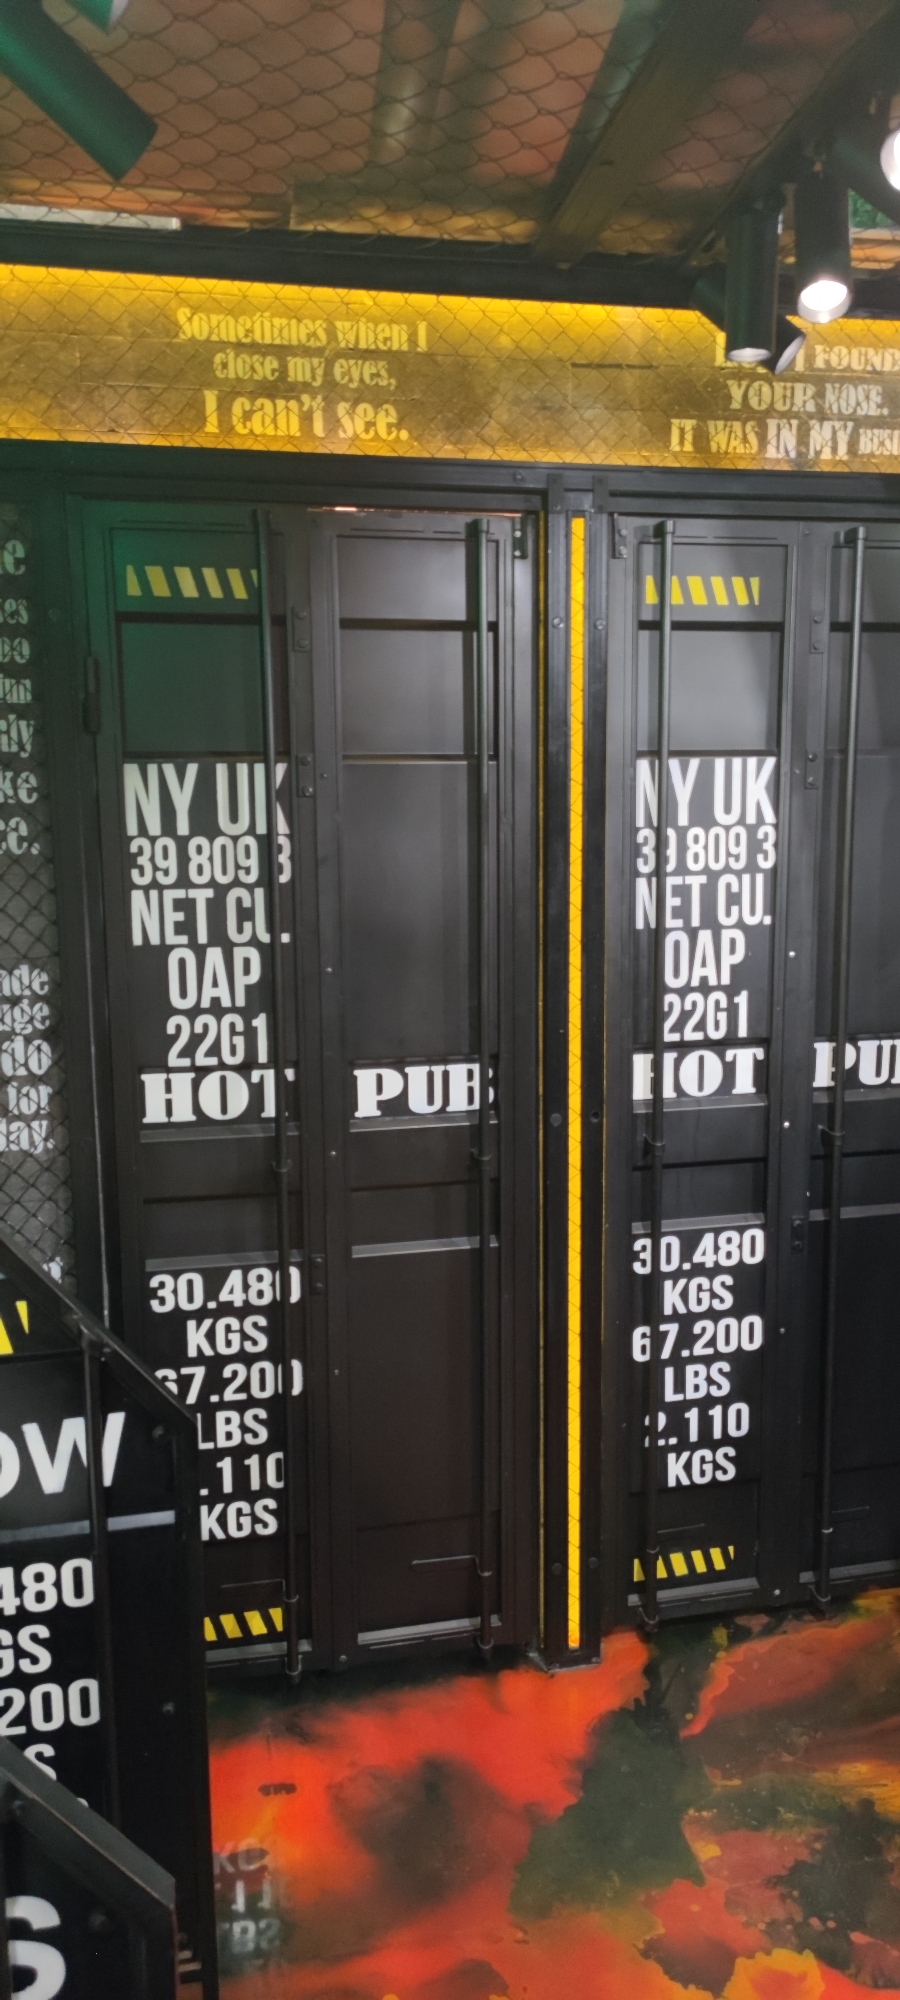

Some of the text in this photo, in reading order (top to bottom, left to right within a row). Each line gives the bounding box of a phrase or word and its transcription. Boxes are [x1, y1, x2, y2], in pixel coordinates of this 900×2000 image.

[177, 307, 428, 351] Sometimes when I
[213, 349, 397, 390] close my eyes,
[203, 390, 410, 441] I can't see.
[726, 380, 889, 416] YOUR NOSE.
[669, 419, 697, 451] IT
[707, 420, 759, 454] WAS
[765, 418, 799, 459] IN
[808, 420, 855, 460] MY
[123, 762, 290, 837] NY UK
[636, 757, 777, 828] NY UK
[130, 837, 178, 886] 39
[187, 835, 260, 885] 809
[686, 826, 747, 872] 809
[756, 825, 776, 870] 3
[131, 888, 215, 946] NET
[636, 873, 772, 930] NET CU.
[168, 946, 262, 1010] OAP
[664, 928, 746, 989] OAP
[166, 1012, 268, 1067] 22G1
[663, 990, 748, 1042] 22G1
[140, 1063, 494, 1124] HOT PUB
[633, 1039, 900, 1100] HOT PU
[632, 1228, 765, 1275] 30.480
[663, 1274, 734, 1316] KGS
[186, 1315, 268, 1358] KGS
[632, 1315, 764, 1363] 67.200
[664, 1361, 731, 1403] LBS
[667, 1446, 736, 1488] KGS
[200, 1498, 278, 1541] KGS
